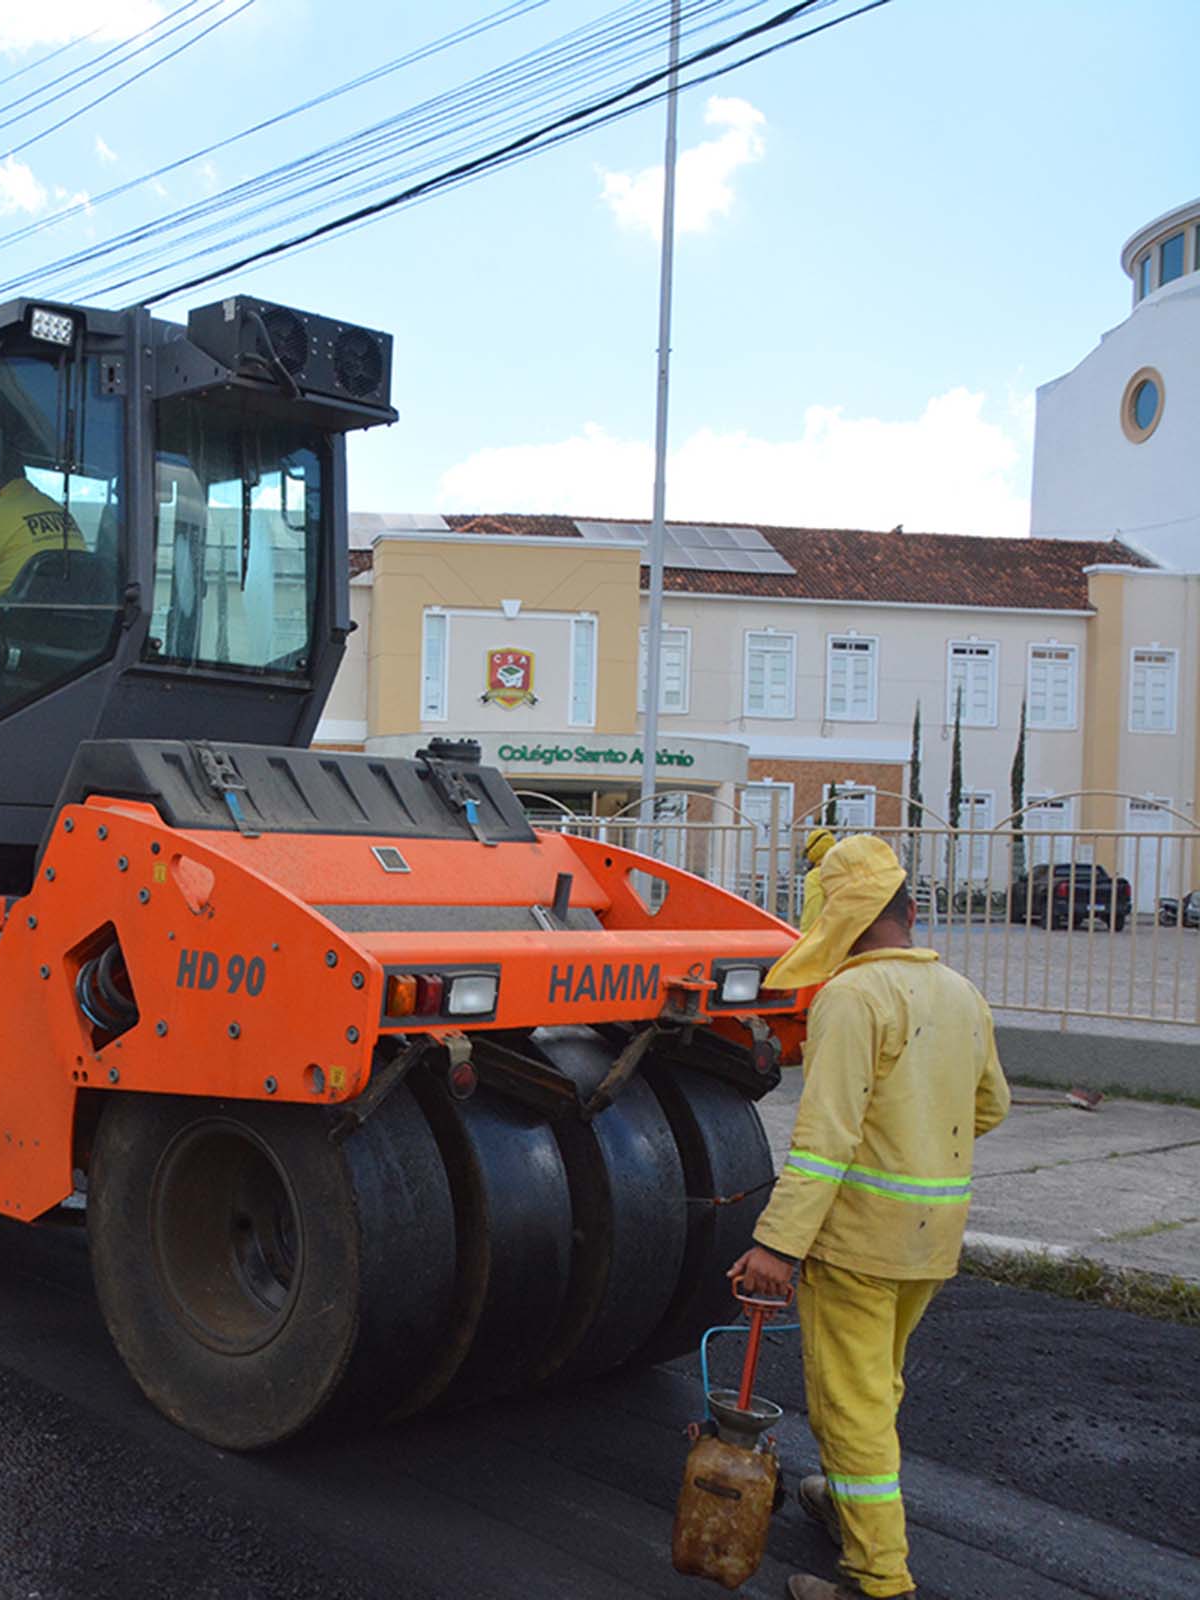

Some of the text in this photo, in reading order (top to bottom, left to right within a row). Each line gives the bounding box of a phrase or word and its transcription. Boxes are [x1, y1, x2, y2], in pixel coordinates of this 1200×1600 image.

[498, 744, 695, 767] Colégio Santo Atônio
[176, 948, 267, 997] HD 90
[548, 963, 660, 1002] HAMM
